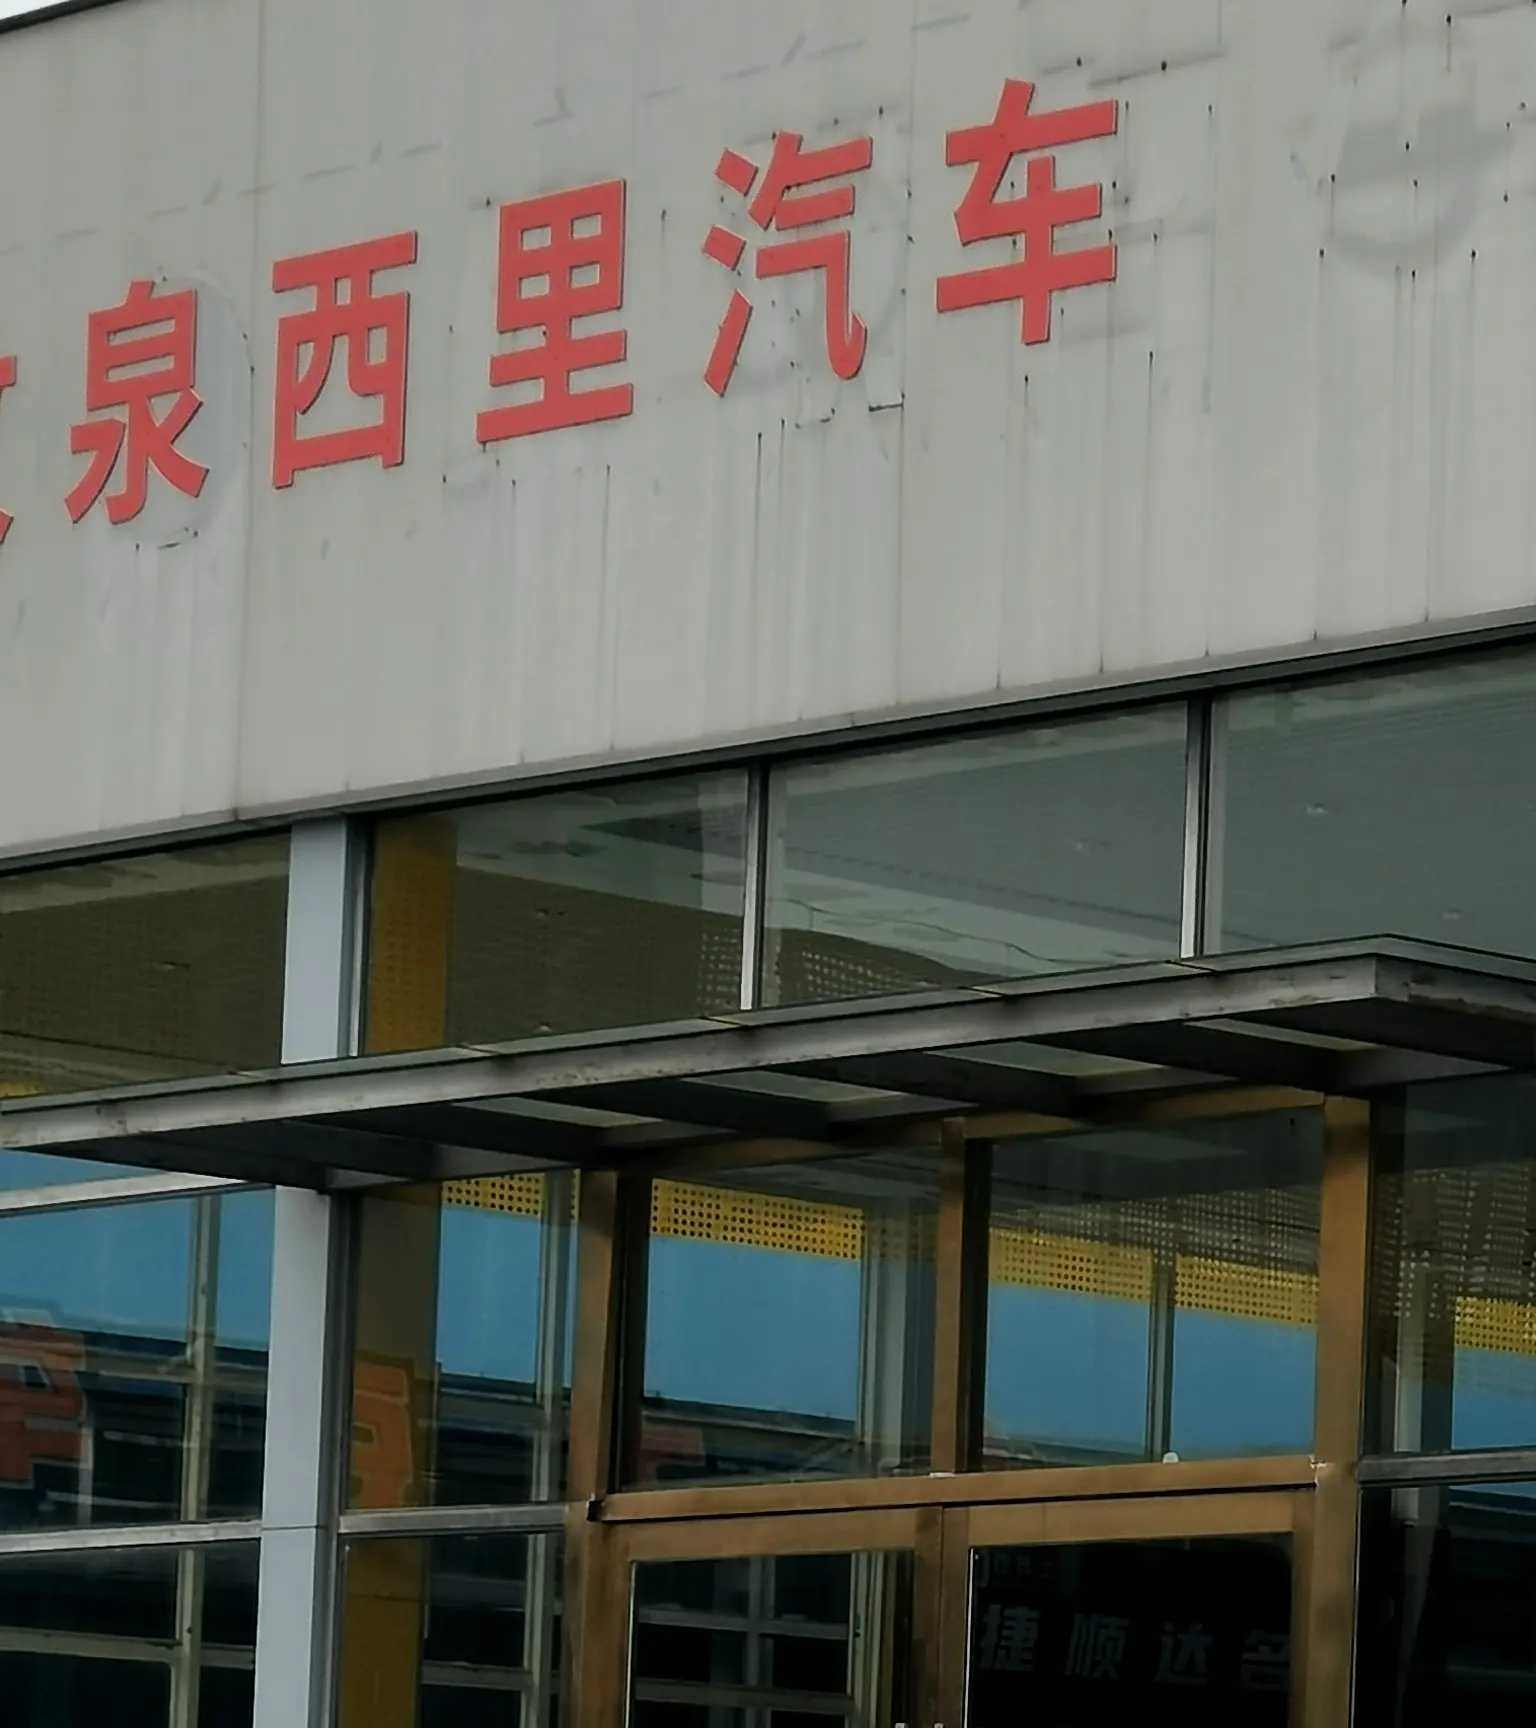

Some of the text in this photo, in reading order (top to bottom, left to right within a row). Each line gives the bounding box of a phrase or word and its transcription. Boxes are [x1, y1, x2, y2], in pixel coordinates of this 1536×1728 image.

[0, 78, 1119, 545] 泉西里汽车
